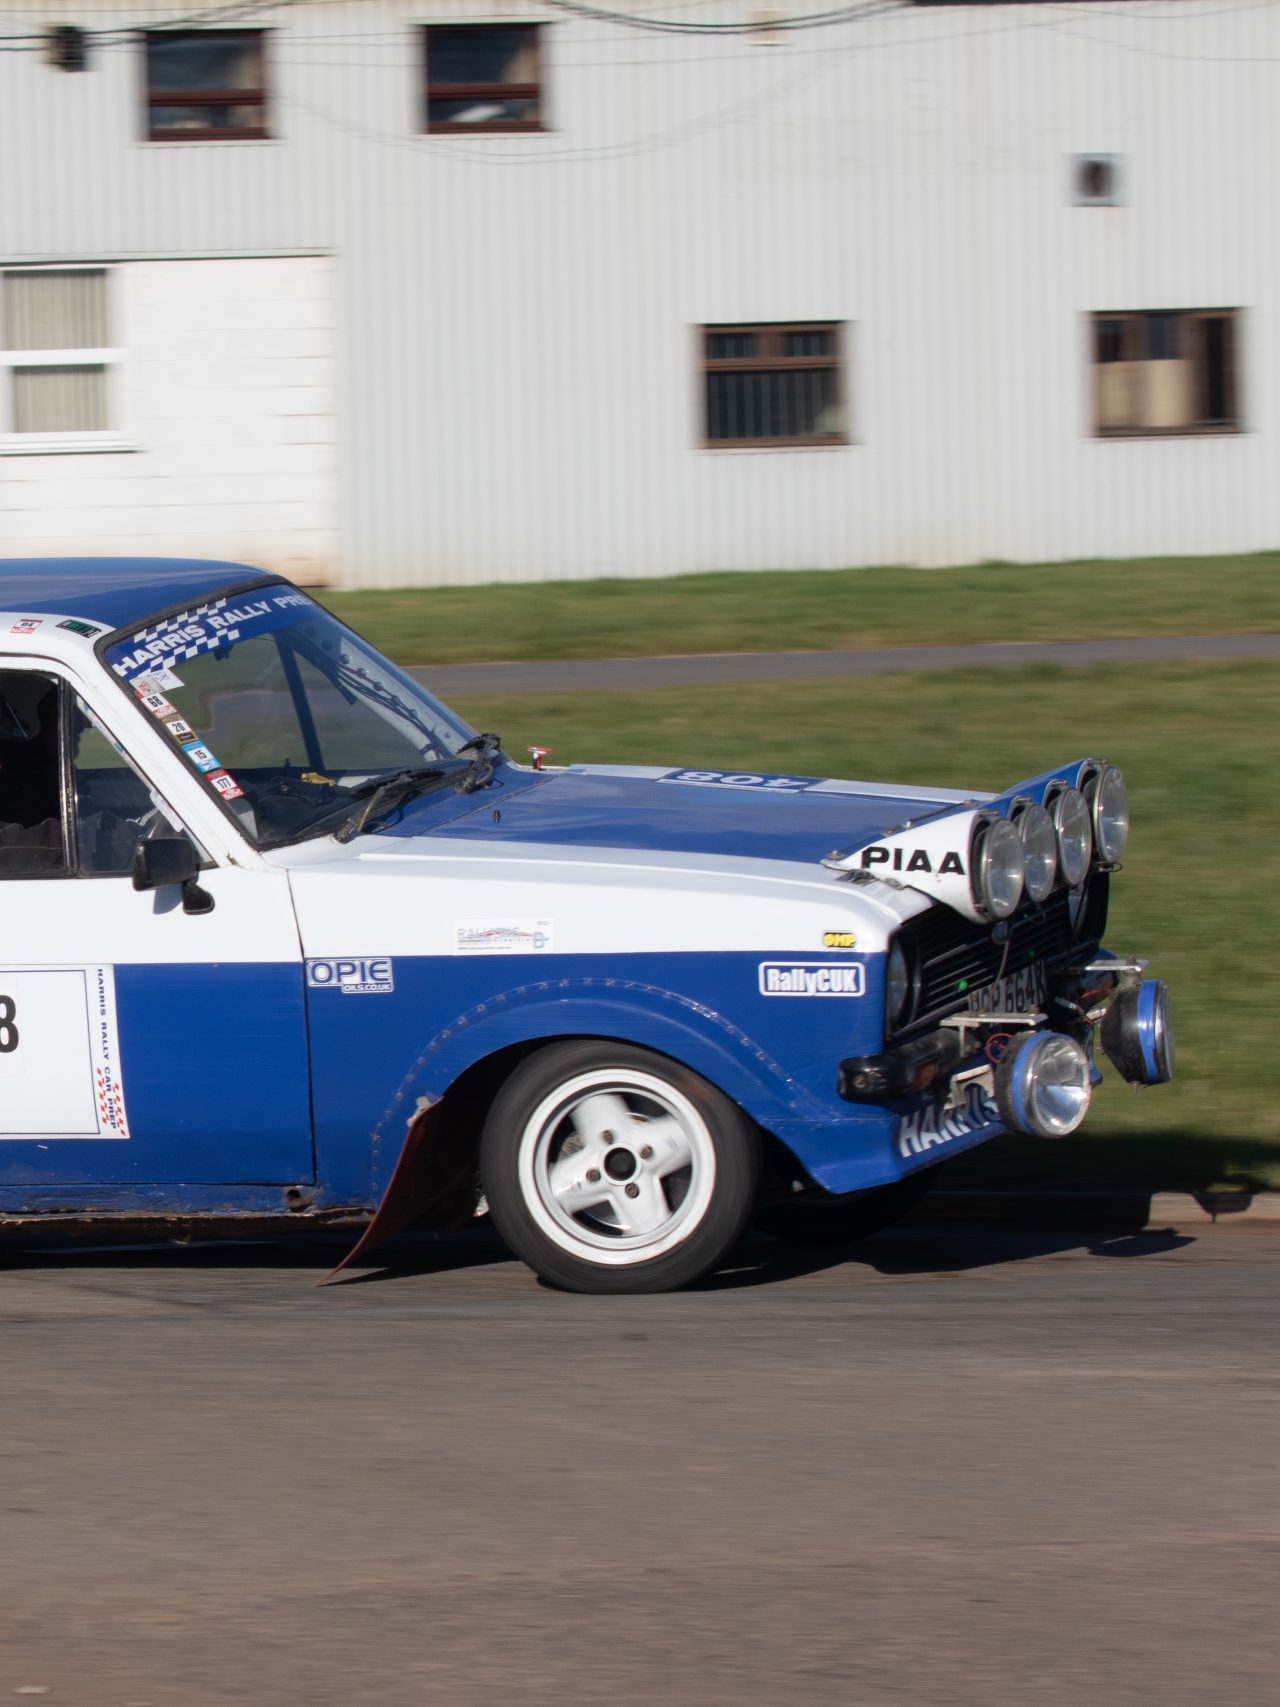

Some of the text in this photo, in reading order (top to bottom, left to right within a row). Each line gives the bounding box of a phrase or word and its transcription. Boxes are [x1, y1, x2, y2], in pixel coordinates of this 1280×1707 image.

[111, 624, 206, 677] HARRIS
[206, 600, 272, 630] RALLY
[147, 695, 164, 707] 68
[172, 722, 185, 732] 20
[195, 749, 207, 760] 15
[217, 777, 232, 789] 177
[677, 771, 809, 787] 408
[861, 846, 966, 875] PIAA
[311, 960, 389, 983] OPIE
[766, 968, 857, 996] RallyCUK
[97, 968, 106, 1016] HARRIS
[101, 1022, 110, 1060] RALLY
[107, 1098, 116, 1129] PREP
